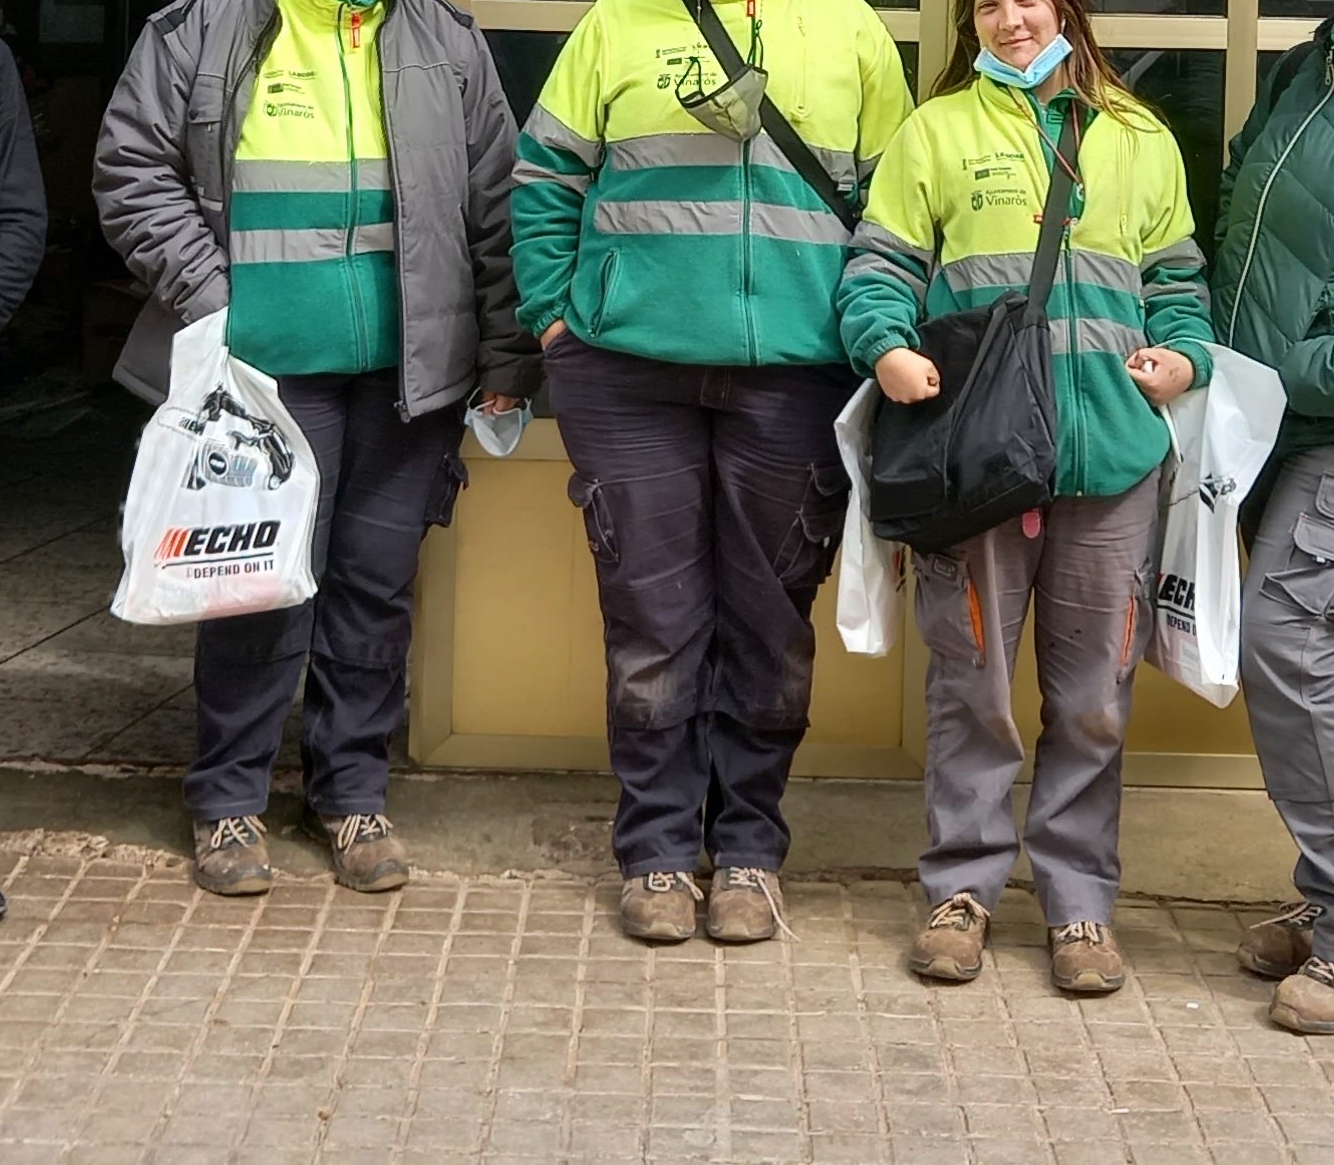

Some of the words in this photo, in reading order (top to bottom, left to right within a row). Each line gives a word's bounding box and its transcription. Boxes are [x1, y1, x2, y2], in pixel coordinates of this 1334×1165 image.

[183, 519, 281, 556] ECHO
[194, 563, 240, 579] DEPEND
[244, 560, 260, 574] ON
[264, 559, 275, 571] IT
[1159, 573, 1196, 612] ECH
